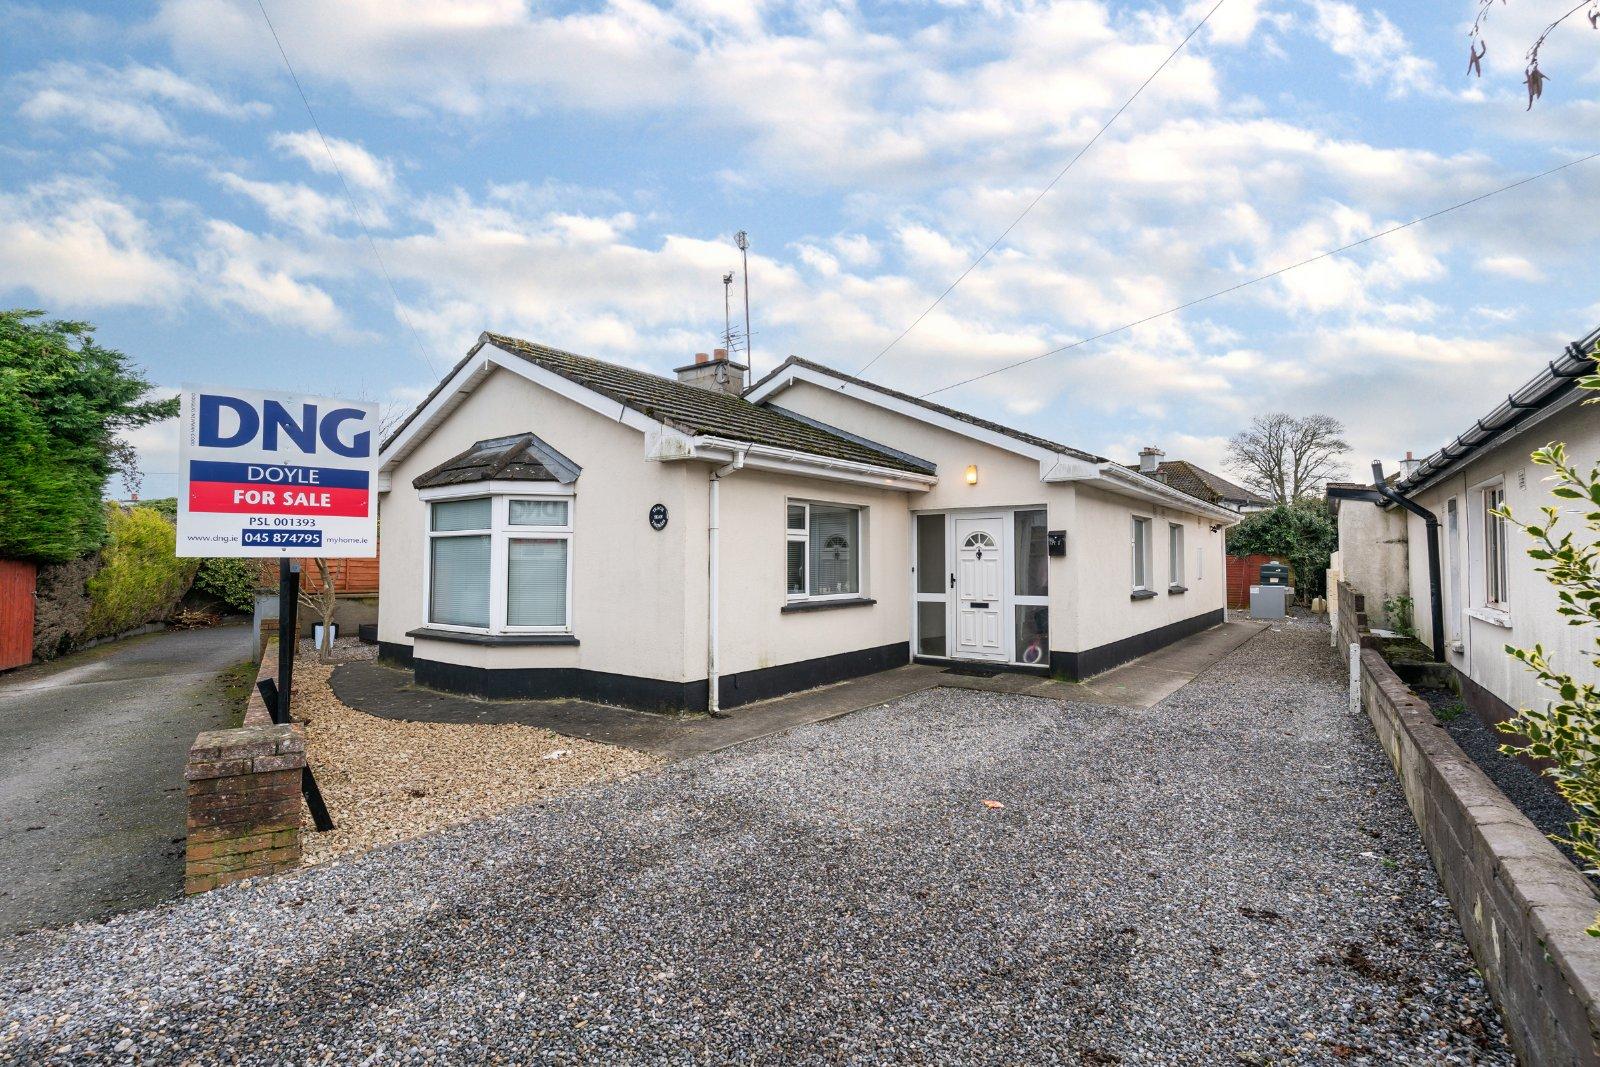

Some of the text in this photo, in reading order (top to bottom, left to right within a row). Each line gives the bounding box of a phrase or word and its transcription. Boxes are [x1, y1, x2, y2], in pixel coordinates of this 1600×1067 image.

[199, 394, 370, 458] DNG
[248, 466, 320, 484] DOYLE
[233, 490, 331, 508] FOR SALE
[249, 517, 316, 527] PSL 001393
[187, 533, 368, 545] www.dng.ie 045 874795 myhome.ie
